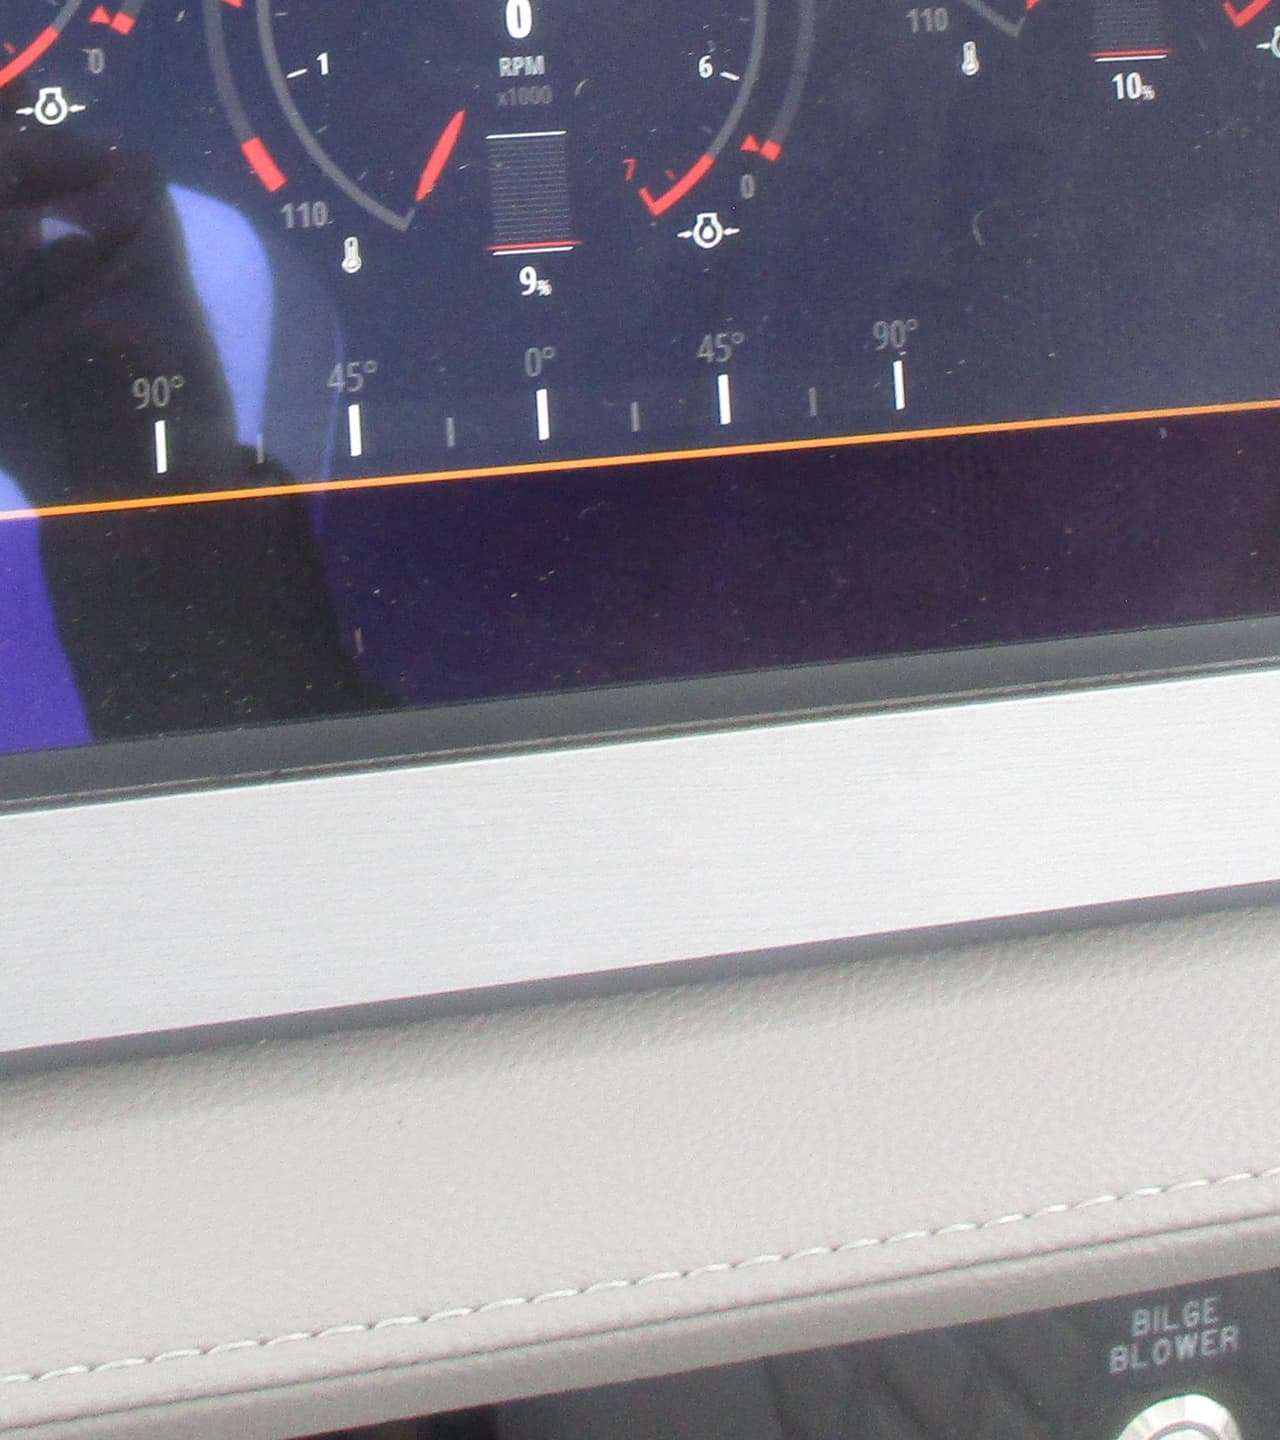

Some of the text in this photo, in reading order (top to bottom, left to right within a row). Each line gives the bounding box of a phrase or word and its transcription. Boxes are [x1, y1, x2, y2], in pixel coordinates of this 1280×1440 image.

[906, 7, 949, 33] 110
[316, 52, 330, 75] 1
[499, 55, 545, 77] RPM
[698, 54, 713, 79] 6
[624, 157, 637, 181] 7
[280, 201, 328, 228] 110
[1131, 1295, 1220, 1337] BILGE
[1109, 1324, 1240, 1375] BLOWER
